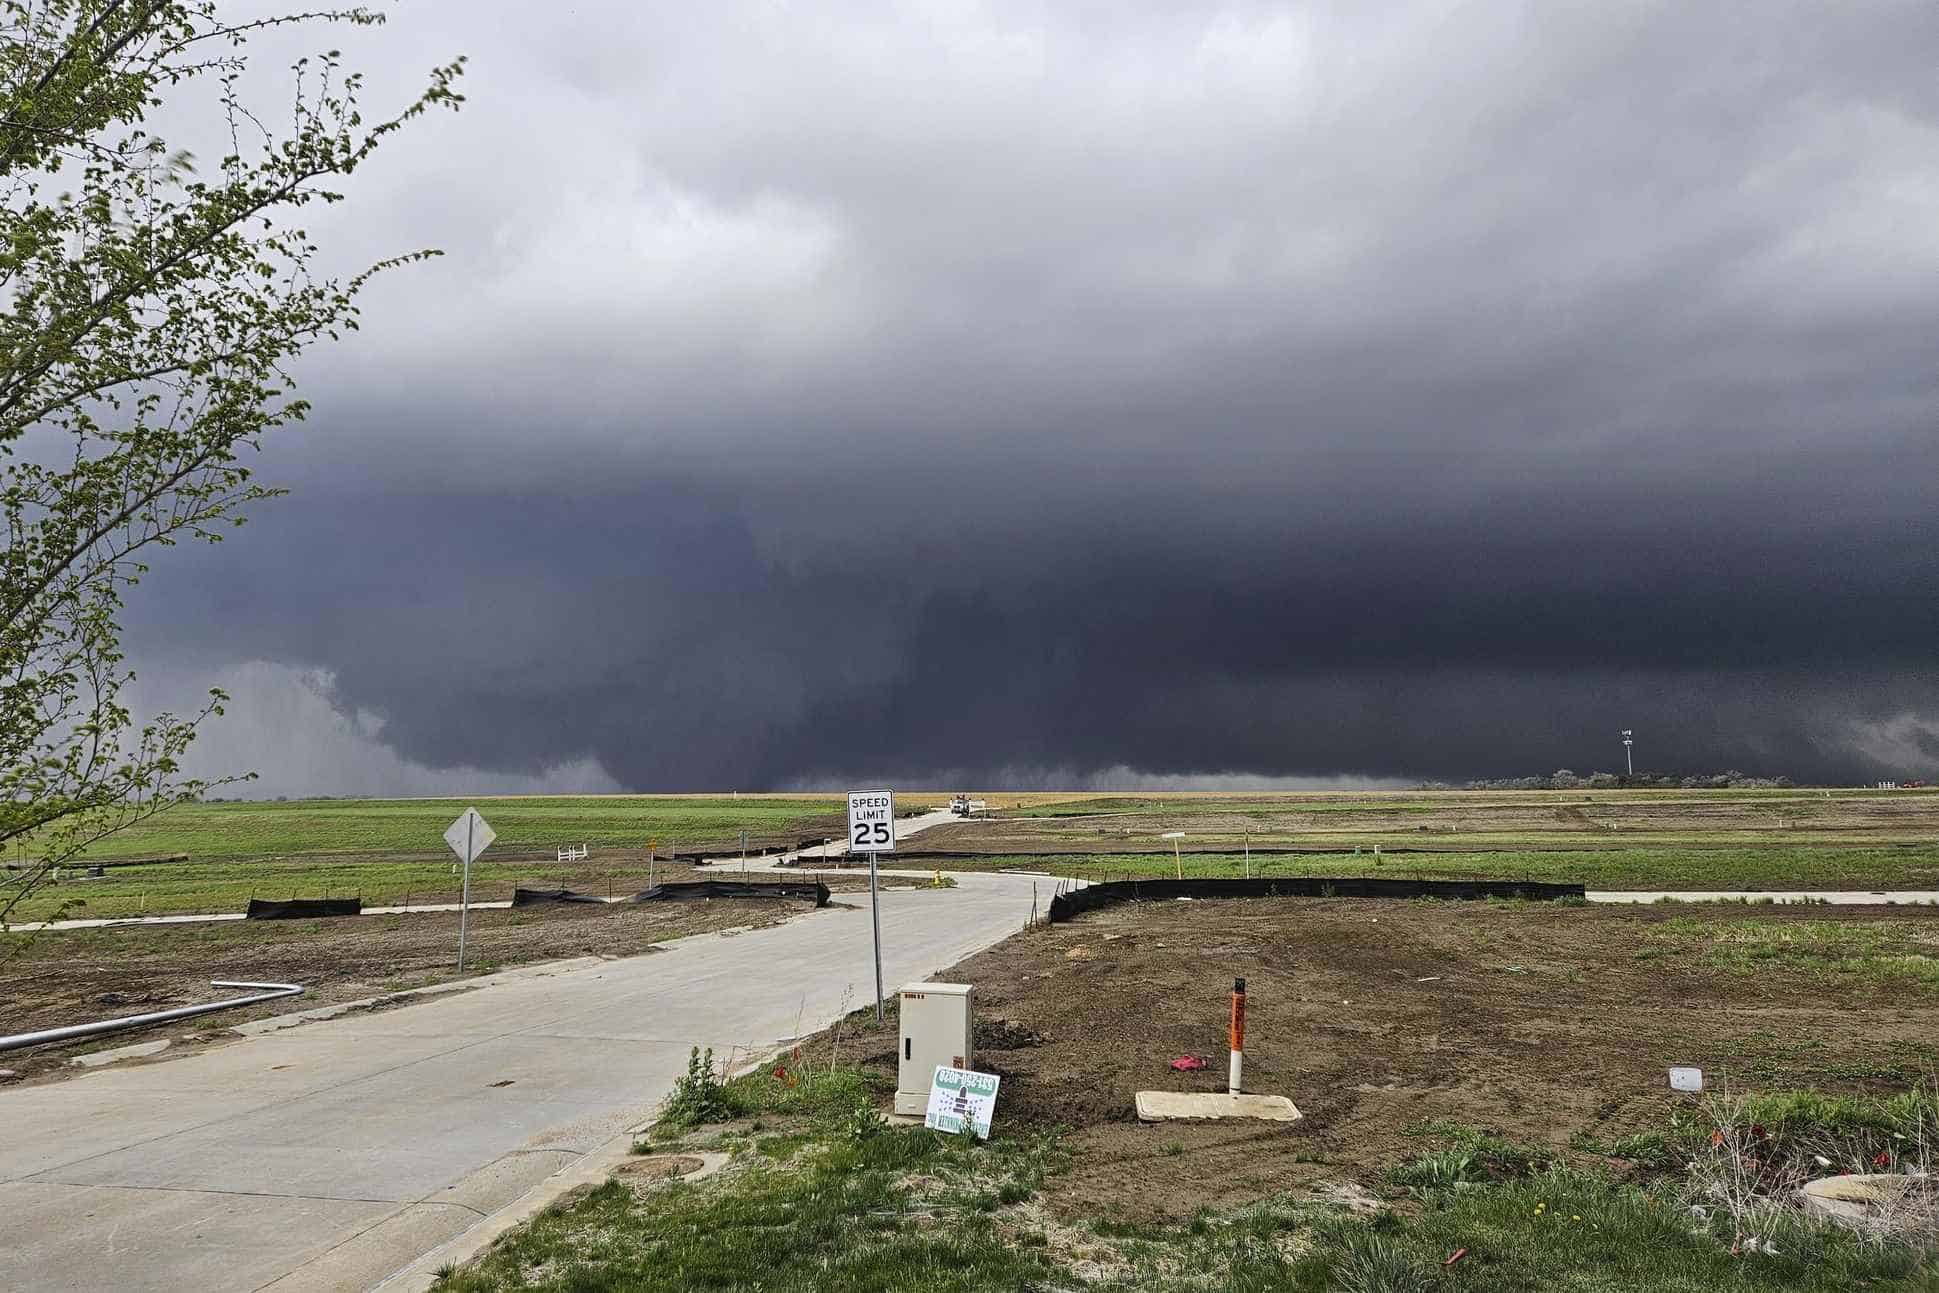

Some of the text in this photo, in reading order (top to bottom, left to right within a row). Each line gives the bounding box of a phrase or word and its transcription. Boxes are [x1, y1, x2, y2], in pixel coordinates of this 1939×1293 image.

[852, 798, 889, 808] SPEED
[856, 810, 885, 820] LIMIT
[854, 823, 890, 845] 25
